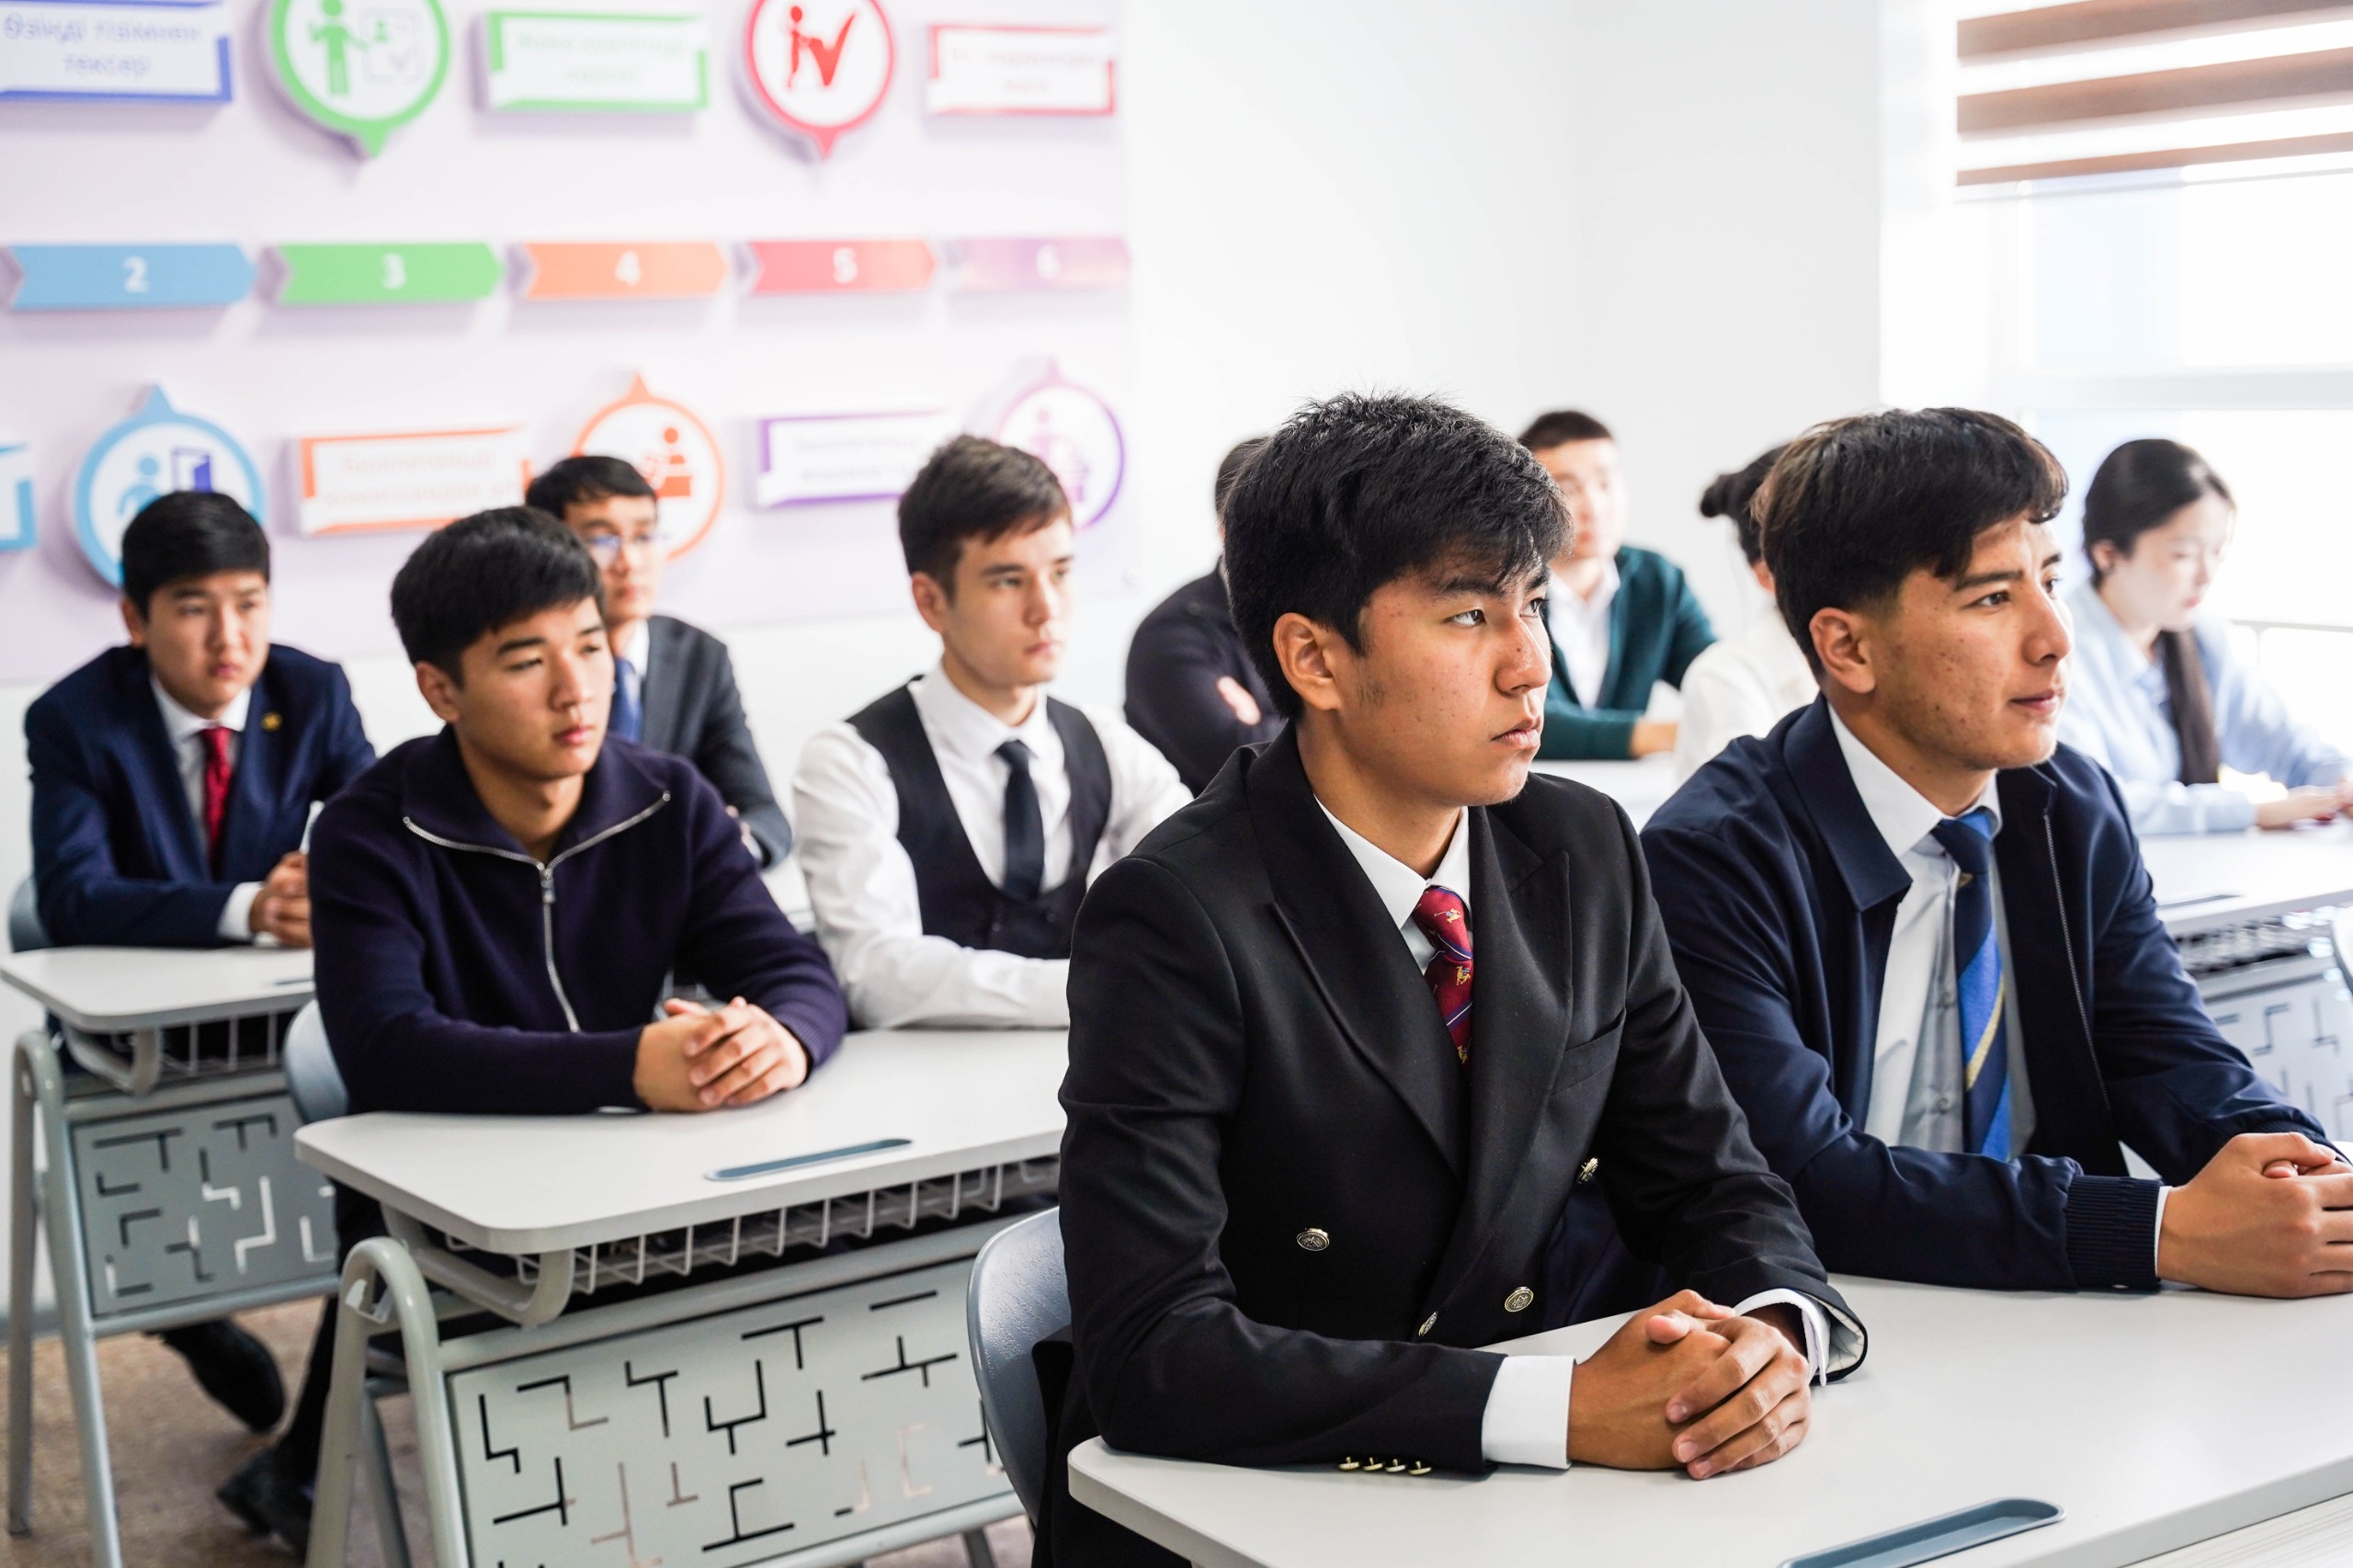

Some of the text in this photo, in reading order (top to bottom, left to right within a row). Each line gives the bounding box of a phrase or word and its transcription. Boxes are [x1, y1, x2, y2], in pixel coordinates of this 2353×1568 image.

[123, 256, 151, 293] 2
[381, 252, 408, 290] 3
[615, 249, 642, 287] 4
[832, 246, 858, 284] 5
